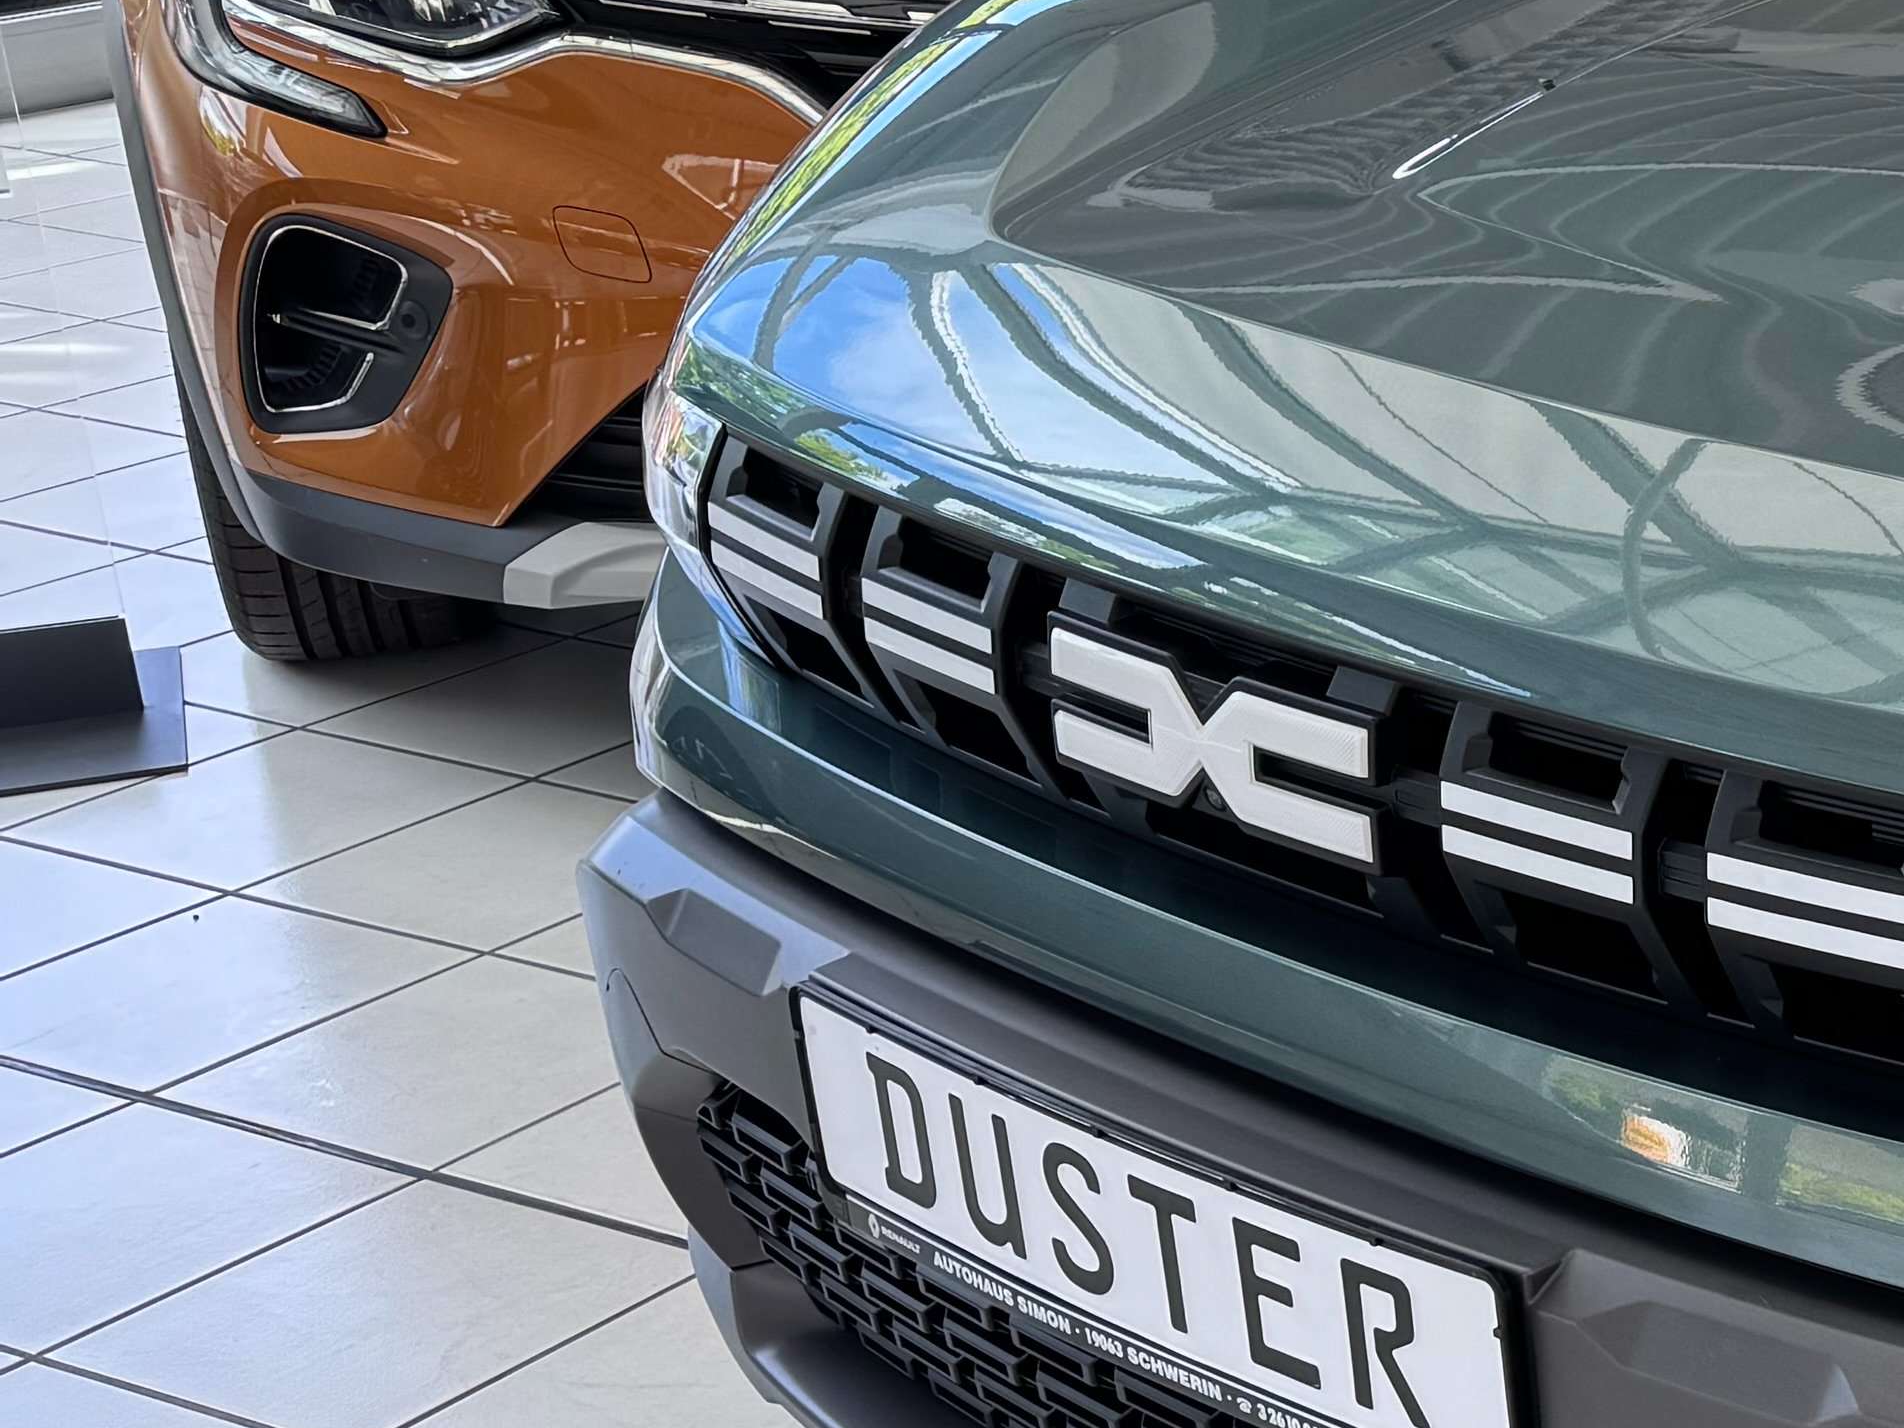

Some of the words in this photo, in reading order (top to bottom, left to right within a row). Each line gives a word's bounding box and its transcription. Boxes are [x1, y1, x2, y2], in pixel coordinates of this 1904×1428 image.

[880, 1225, 921, 1254] RENAULT
[932, 1250, 1015, 1307] AUTOHAUS
[1016, 1295, 1072, 1335] SIMON
[1085, 1326, 1124, 1359] 19063
[1127, 1345, 1222, 1403] SCHWERIN
